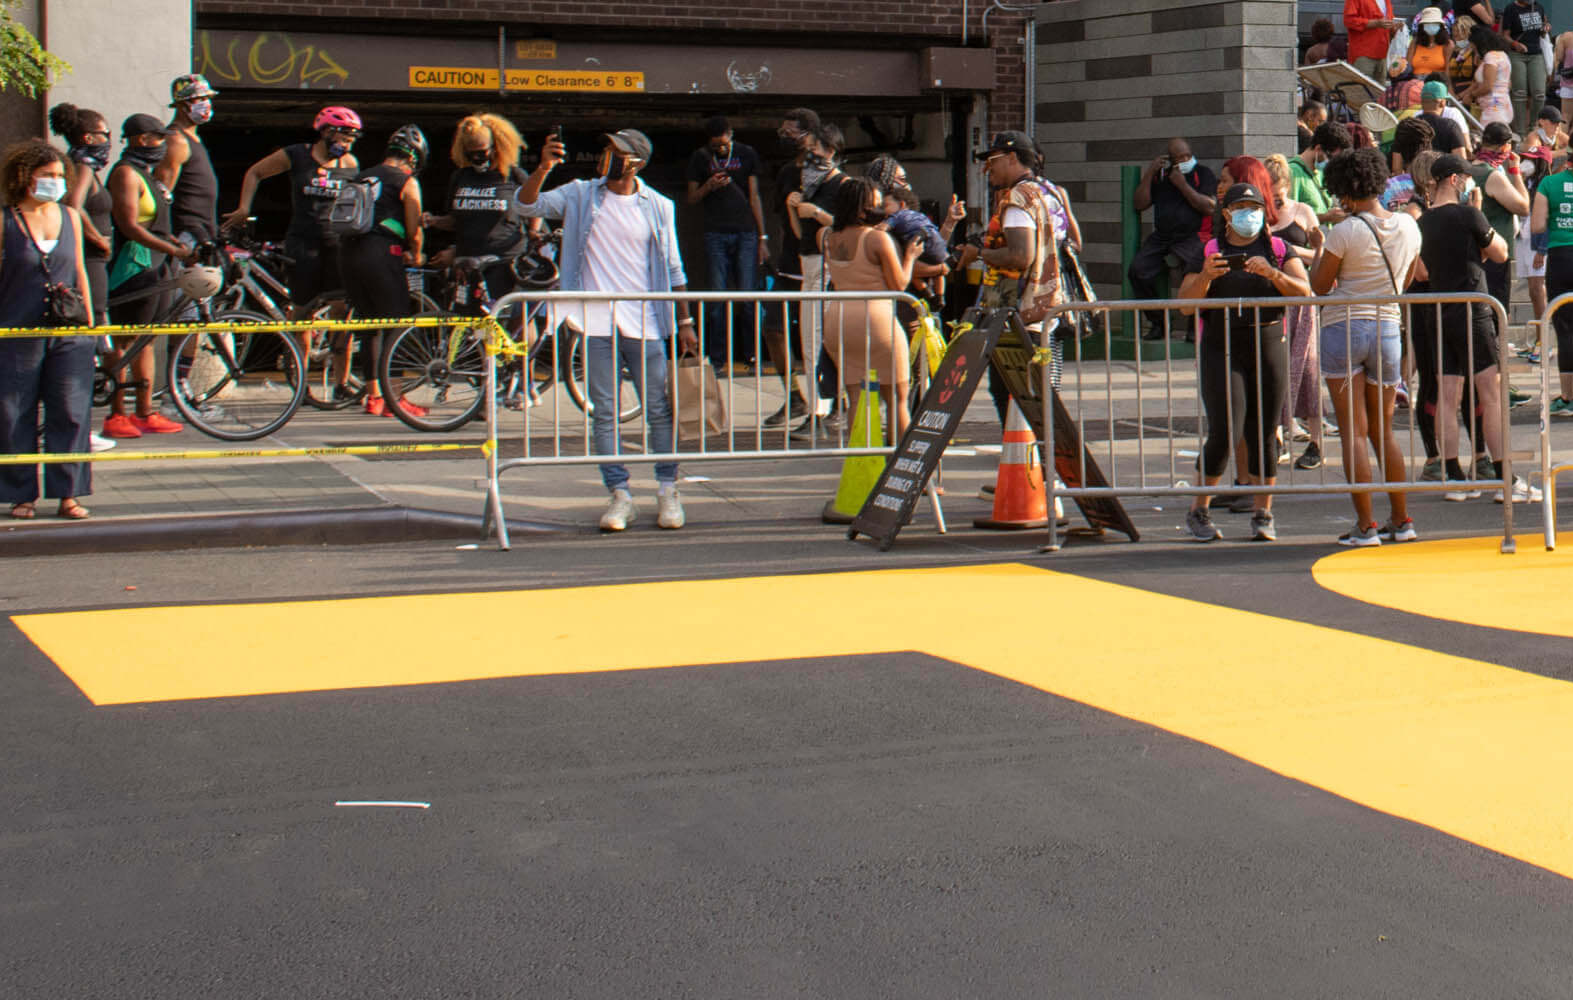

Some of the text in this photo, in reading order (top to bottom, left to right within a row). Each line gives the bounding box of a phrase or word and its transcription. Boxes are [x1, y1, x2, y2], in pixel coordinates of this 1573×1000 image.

[414, 70, 485, 86] CAUTION
[504, 74, 530, 86] Low
[535, 75, 601, 88] Clearance
